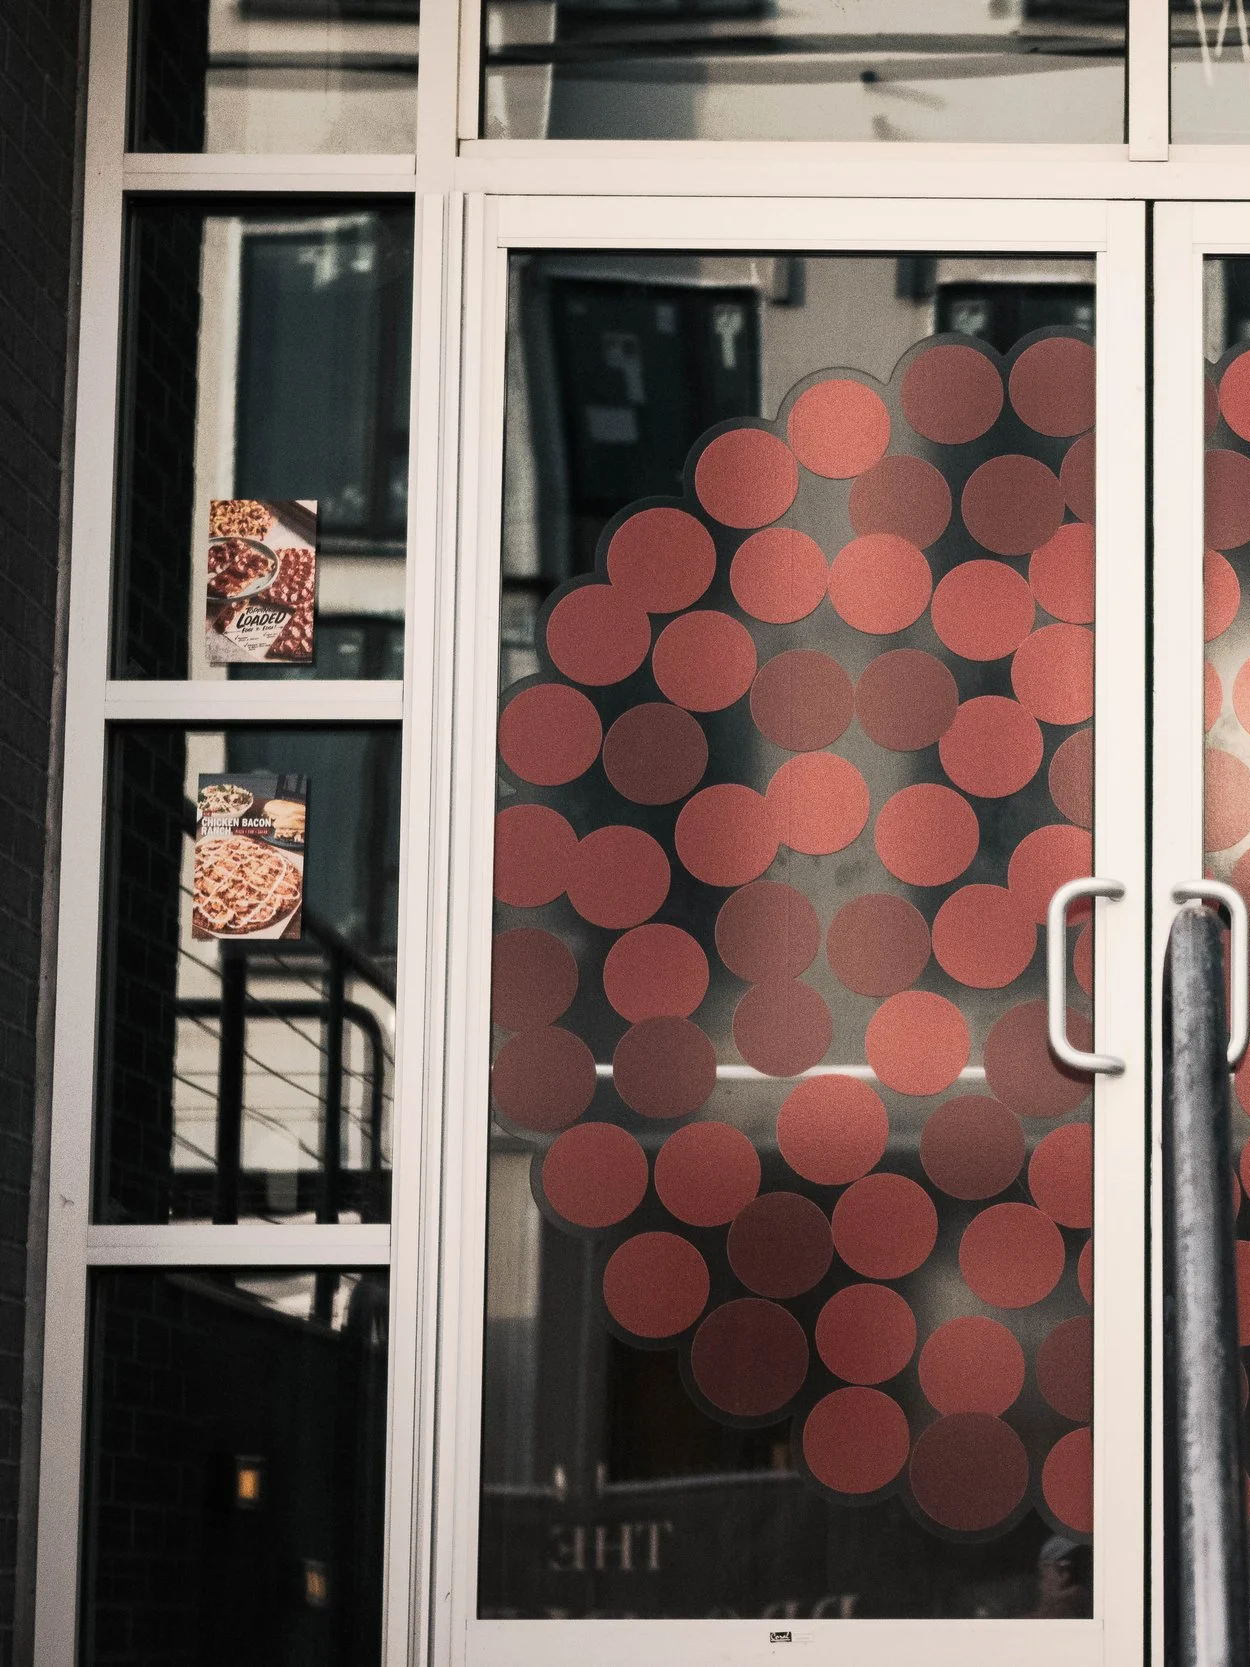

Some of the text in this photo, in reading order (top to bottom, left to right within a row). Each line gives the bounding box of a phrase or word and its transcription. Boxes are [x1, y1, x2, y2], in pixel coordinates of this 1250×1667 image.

[237, 611, 287, 629] LOADED
[201, 818, 271, 827] CHICKEN BACON
[201, 827, 231, 836] RANCH
